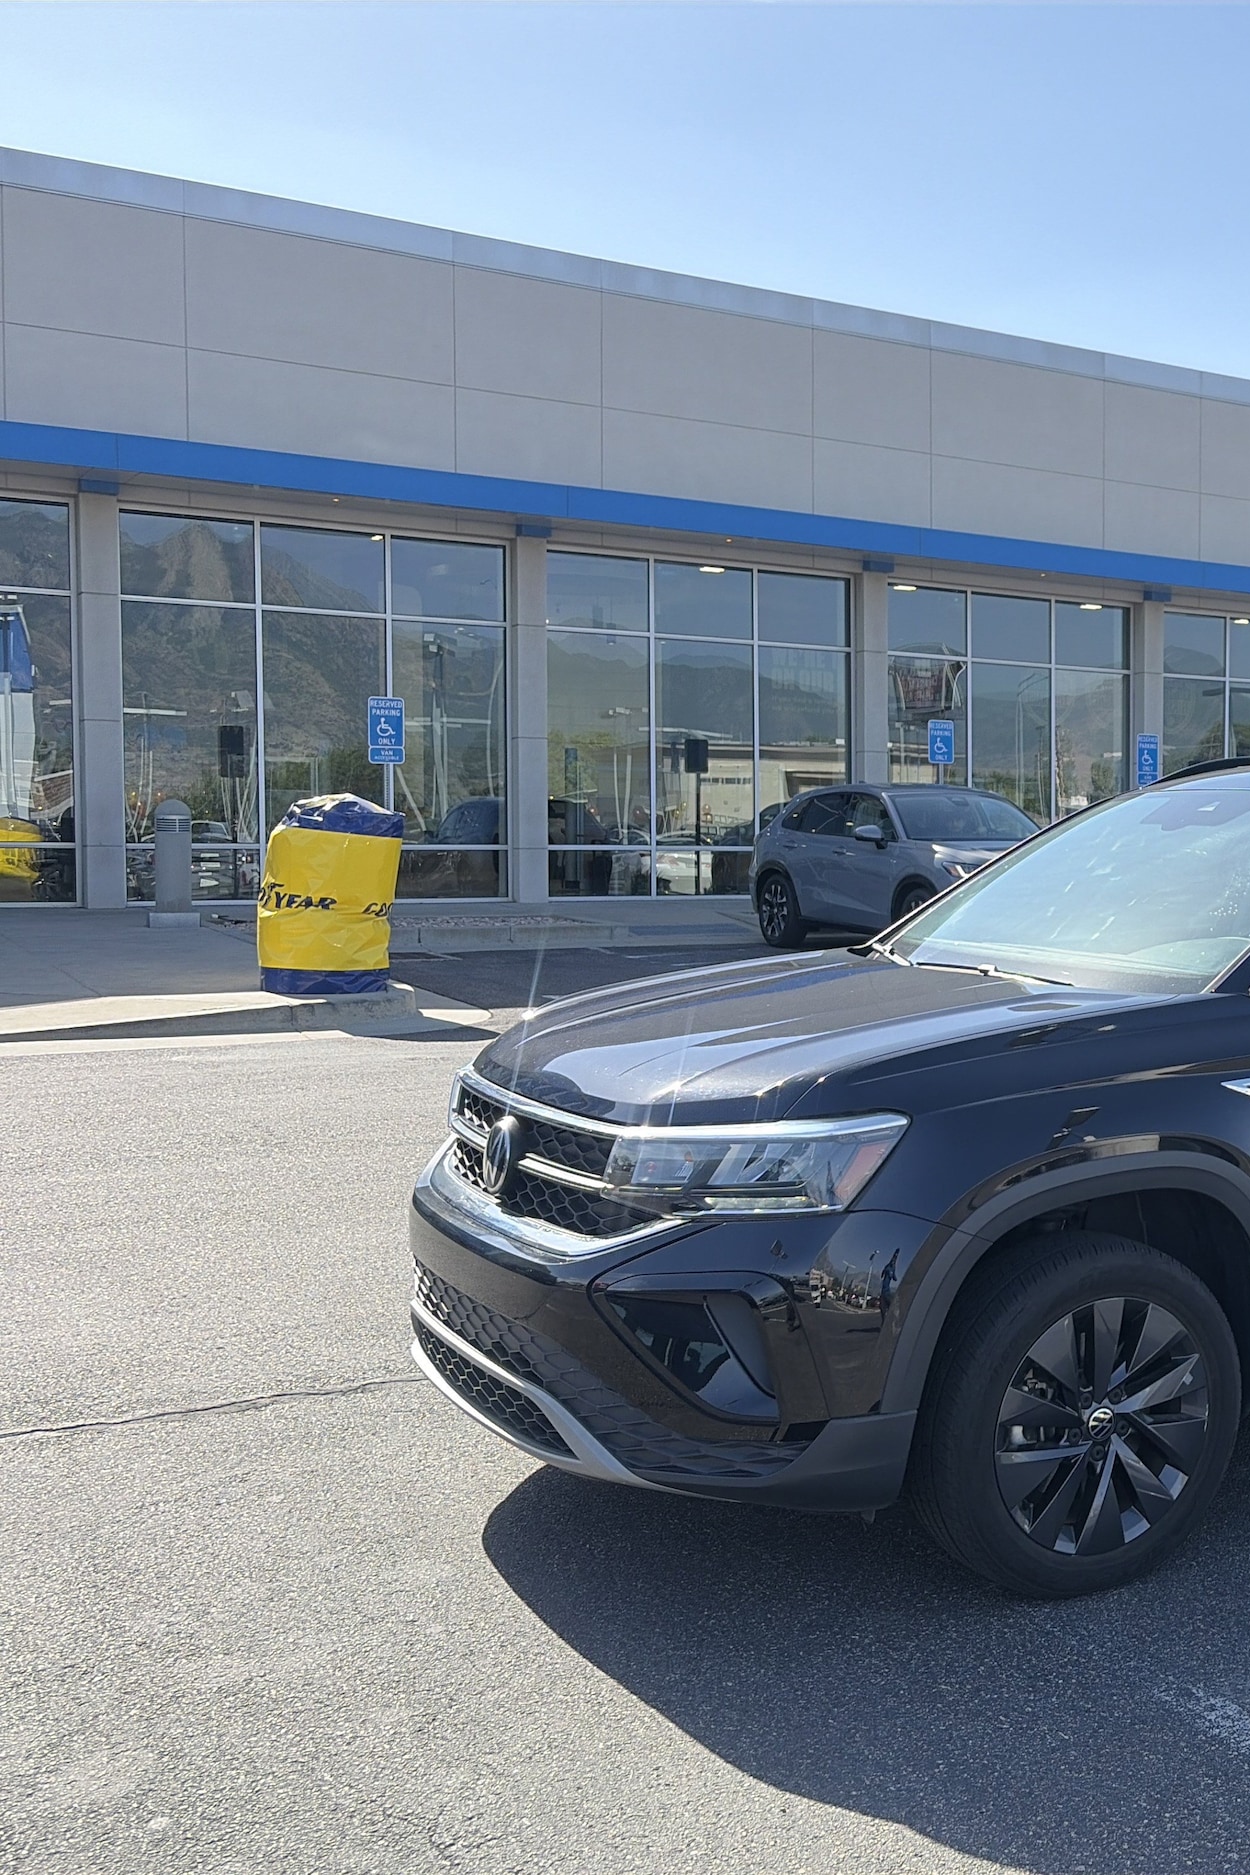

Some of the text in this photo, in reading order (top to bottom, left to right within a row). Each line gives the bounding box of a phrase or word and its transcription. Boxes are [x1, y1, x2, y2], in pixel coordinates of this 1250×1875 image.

[370, 699, 403, 709] RESERVED
[371, 708, 401, 717] PARKING
[378, 737, 396, 746] ONLY
